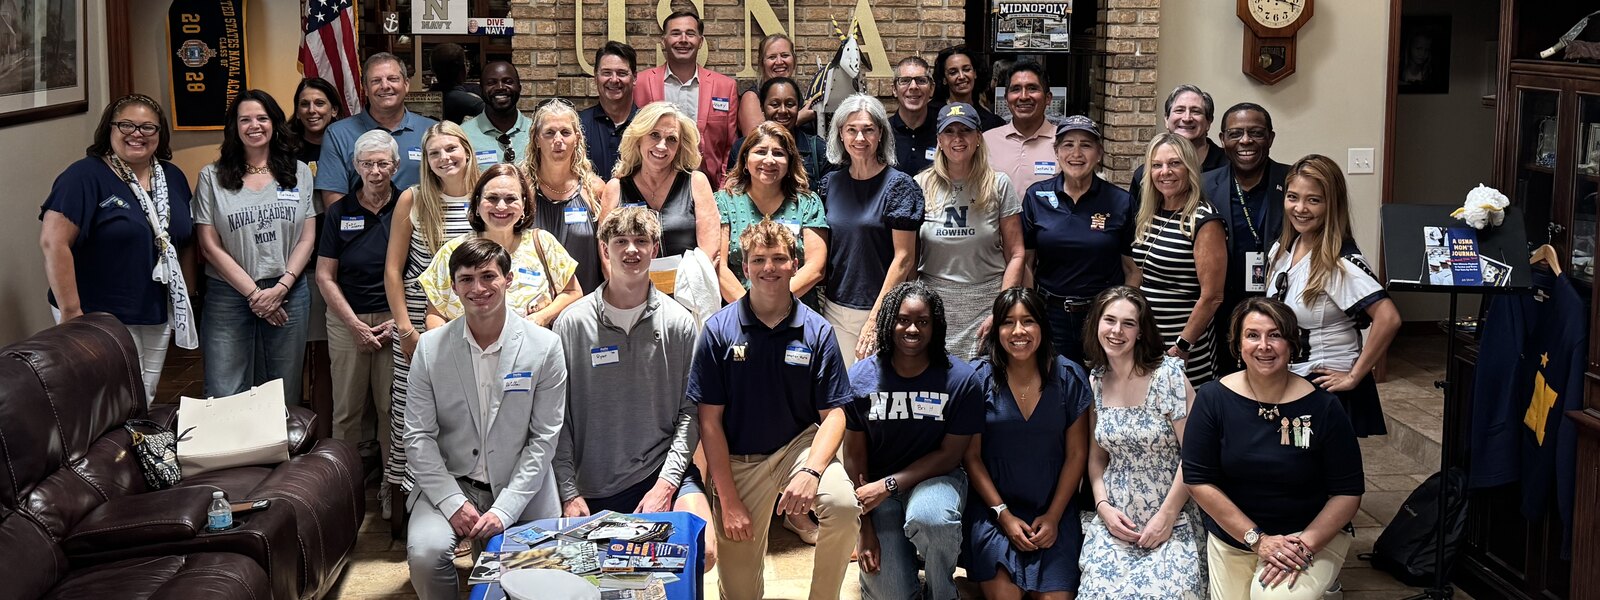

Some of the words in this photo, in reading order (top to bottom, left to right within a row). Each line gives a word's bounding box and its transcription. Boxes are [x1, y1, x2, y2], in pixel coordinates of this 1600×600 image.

[999, 3, 1068, 15] MIDNOPOLY
[224, 18, 240, 49] STATES
[421, 21, 452, 29] NAVY
[219, 37, 228, 58] CLASS
[228, 50, 241, 77] NAVAL
[227, 211, 256, 233] NAVAL
[257, 206, 297, 224] ACADEMY
[944, 206, 970, 227] N
[254, 230, 277, 245] MOM
[936, 228, 976, 236] ROWING
[868, 391, 950, 422] NAVY
